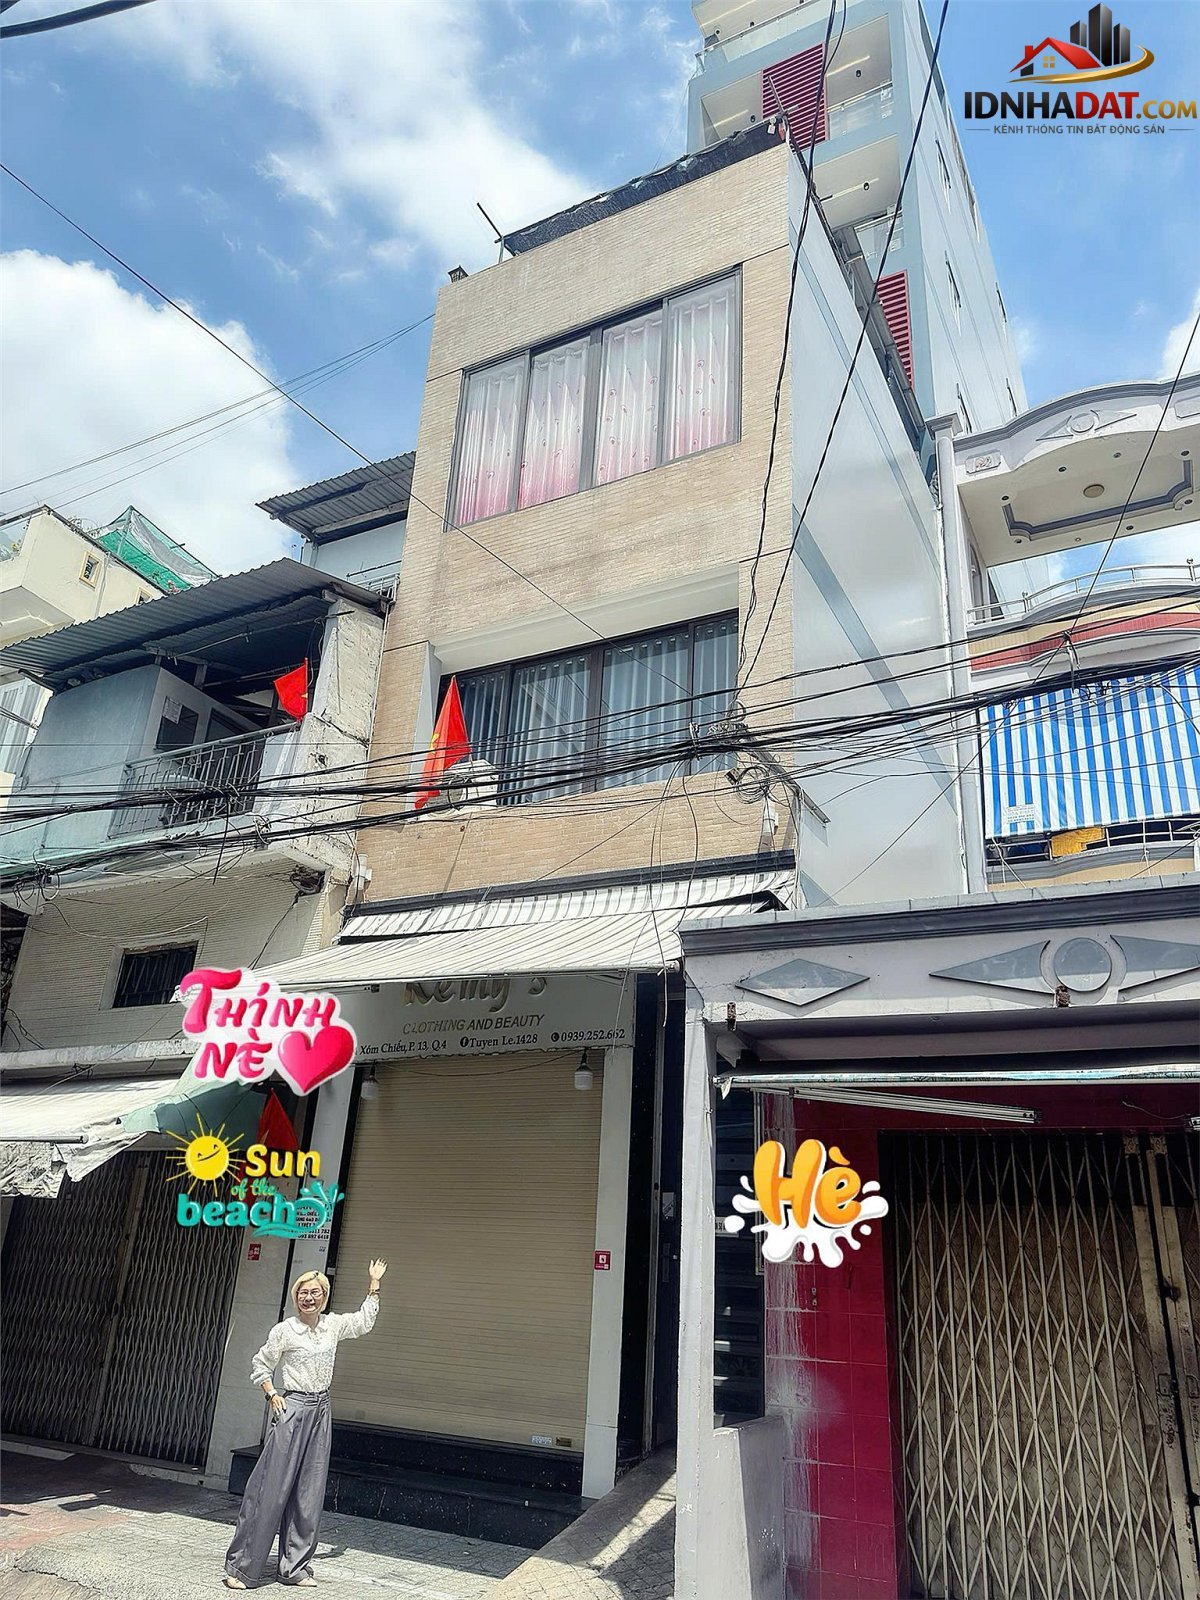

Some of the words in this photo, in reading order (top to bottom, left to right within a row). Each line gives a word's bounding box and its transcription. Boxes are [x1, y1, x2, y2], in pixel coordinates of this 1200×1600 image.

[402, 1019, 465, 1035] CLOTHING
[466, 1017, 494, 1031] AND
[494, 1014, 546, 1029] BEAUTY
[469, 1037, 499, 1049] Tuyen
[502, 1034, 538, 1047] Le.1428
